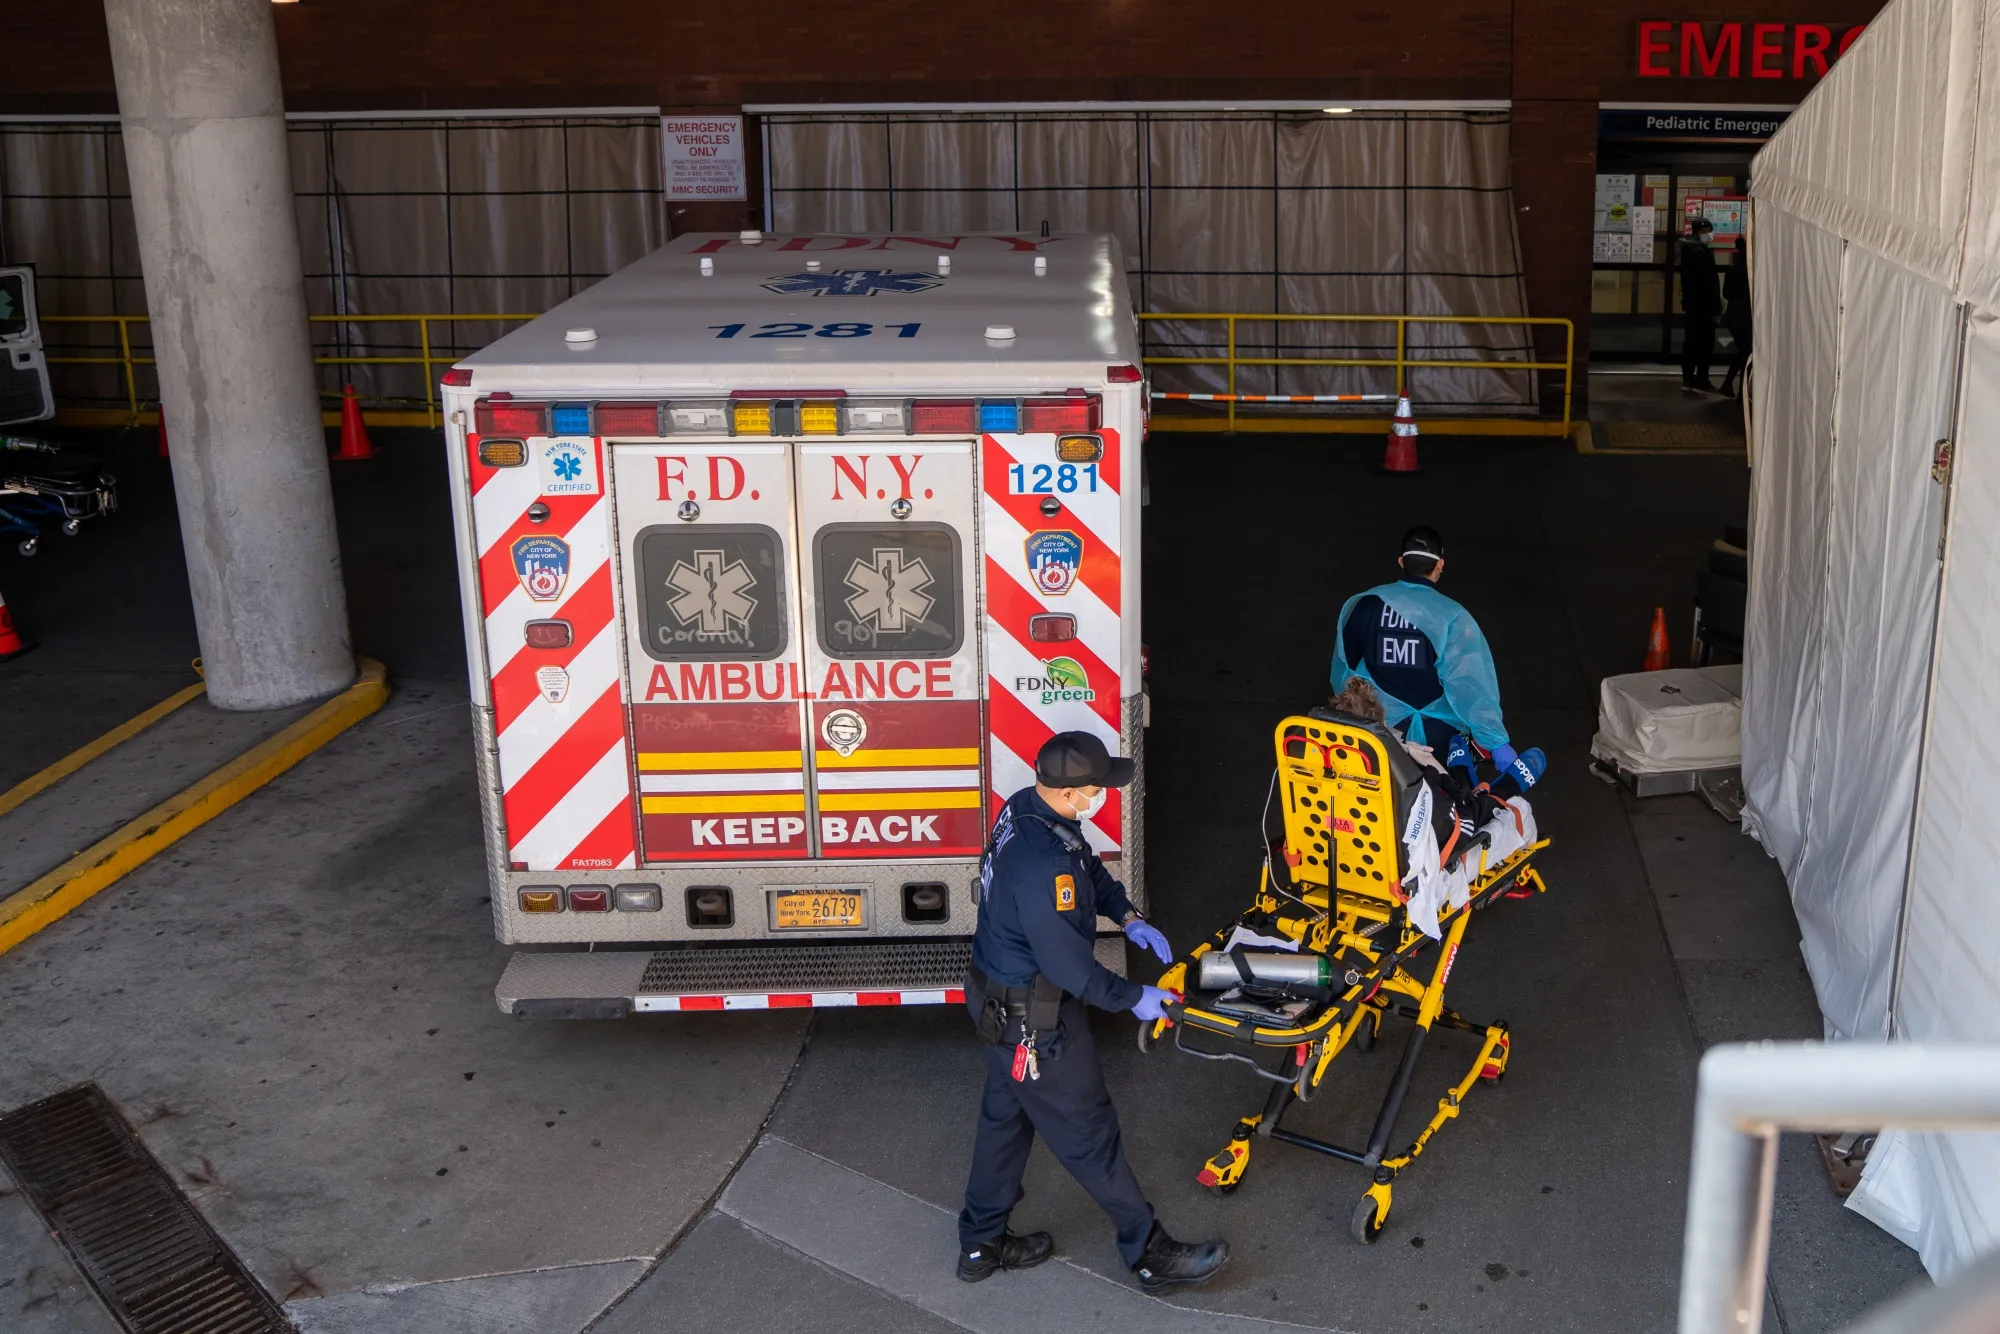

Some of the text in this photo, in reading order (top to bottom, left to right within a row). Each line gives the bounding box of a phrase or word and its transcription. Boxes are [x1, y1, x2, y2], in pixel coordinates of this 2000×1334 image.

[667, 122, 737, 133] EMERGENCY
[1646, 116, 1784, 134] Pediatric Emergen
[676, 135, 730, 145] VEHICLES
[689, 147, 718, 157] ONLY
[672, 186, 739, 194] MMC SECURITY
[689, 237, 1070, 254] FDNY
[707, 322, 923, 339] 1281
[545, 446, 556, 457] NEW
[571, 443, 588, 456] STATE
[655, 456, 761, 501] F.D.
[831, 455, 934, 501] N.Y.
[1010, 463, 1099, 494] 1281
[547, 483, 592, 492] CERTIFIED
[527, 539, 566, 554] DEPARTMENT
[1041, 534, 1078, 549] DEPARTMENT
[1382, 637, 1420, 665] EMT
[645, 661, 954, 701] AMBULANCE
[1016, 676, 1069, 691] FDNY
[1041, 690, 1094, 705] green
[691, 815, 941, 846] KEEP BACK
[572, 858, 612, 867] FA17083
[784, 900, 797, 908] City
[822, 897, 856, 917] 6739
